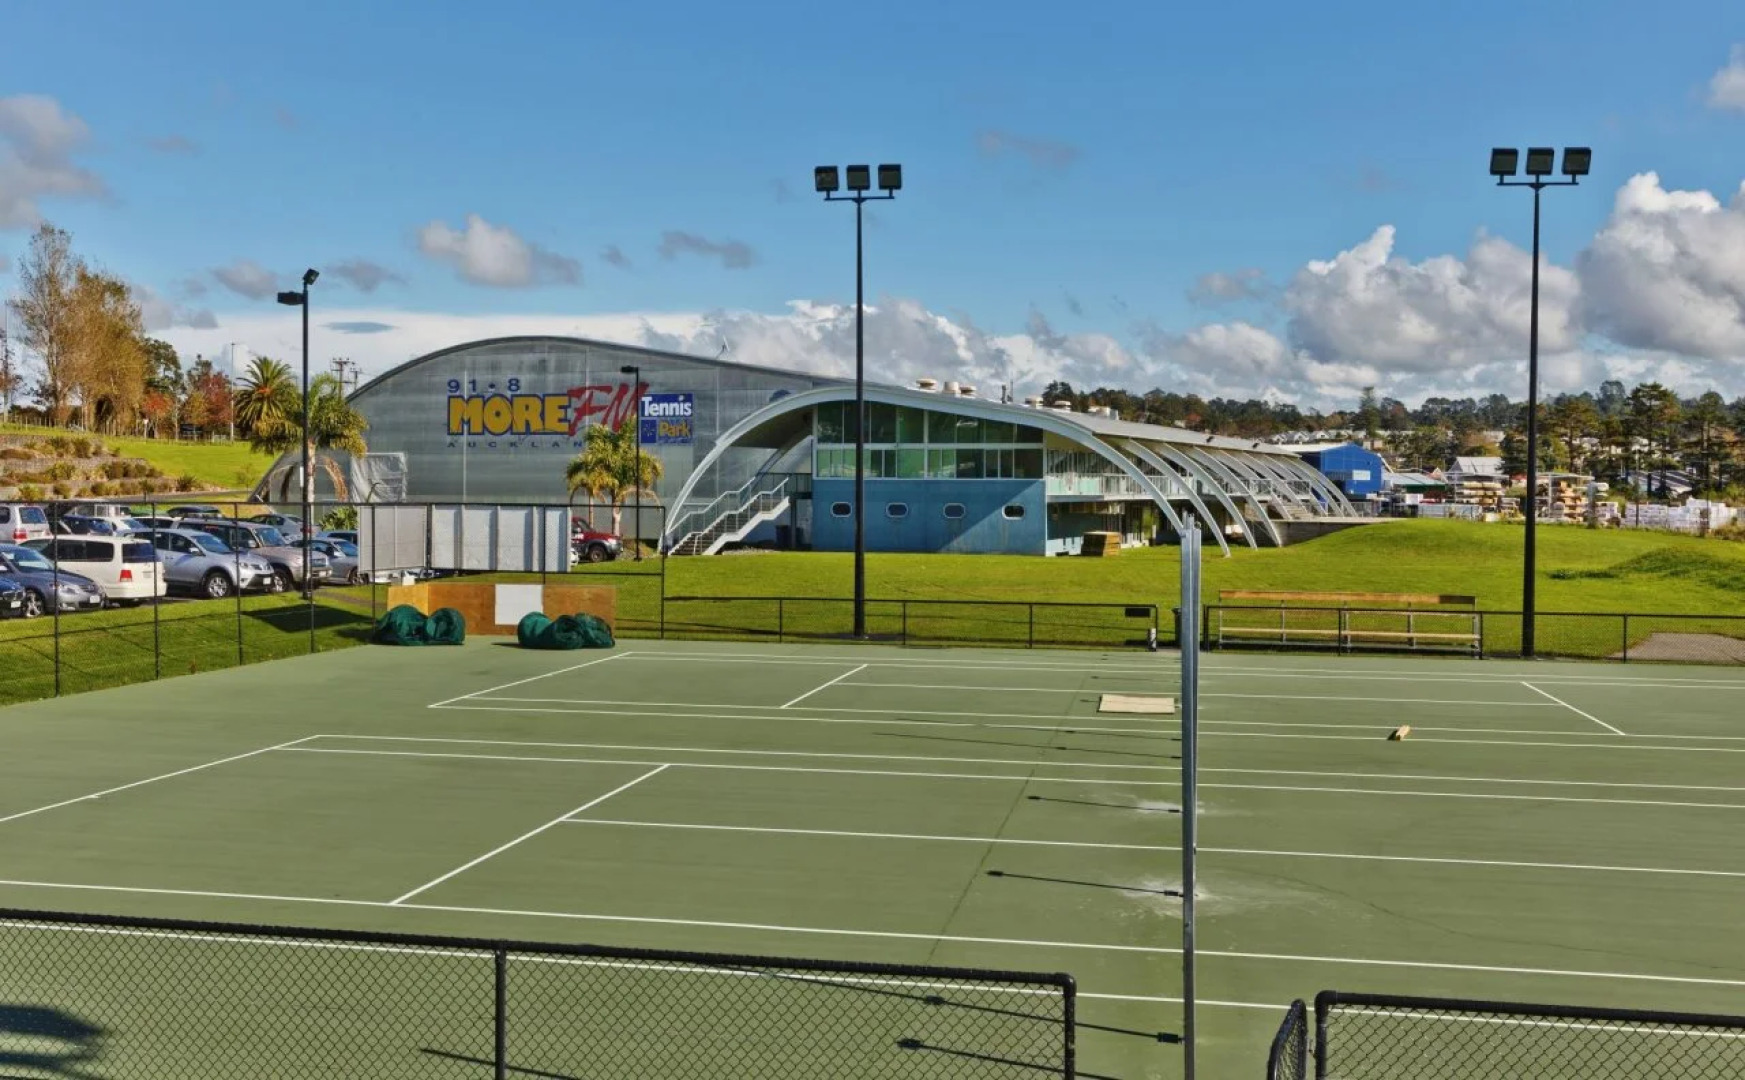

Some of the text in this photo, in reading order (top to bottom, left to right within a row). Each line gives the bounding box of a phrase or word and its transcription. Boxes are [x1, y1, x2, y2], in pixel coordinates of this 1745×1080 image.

[447, 382, 649, 436] MORE FM
[641, 395, 692, 417] Tennis
[658, 421, 690, 437] Park
